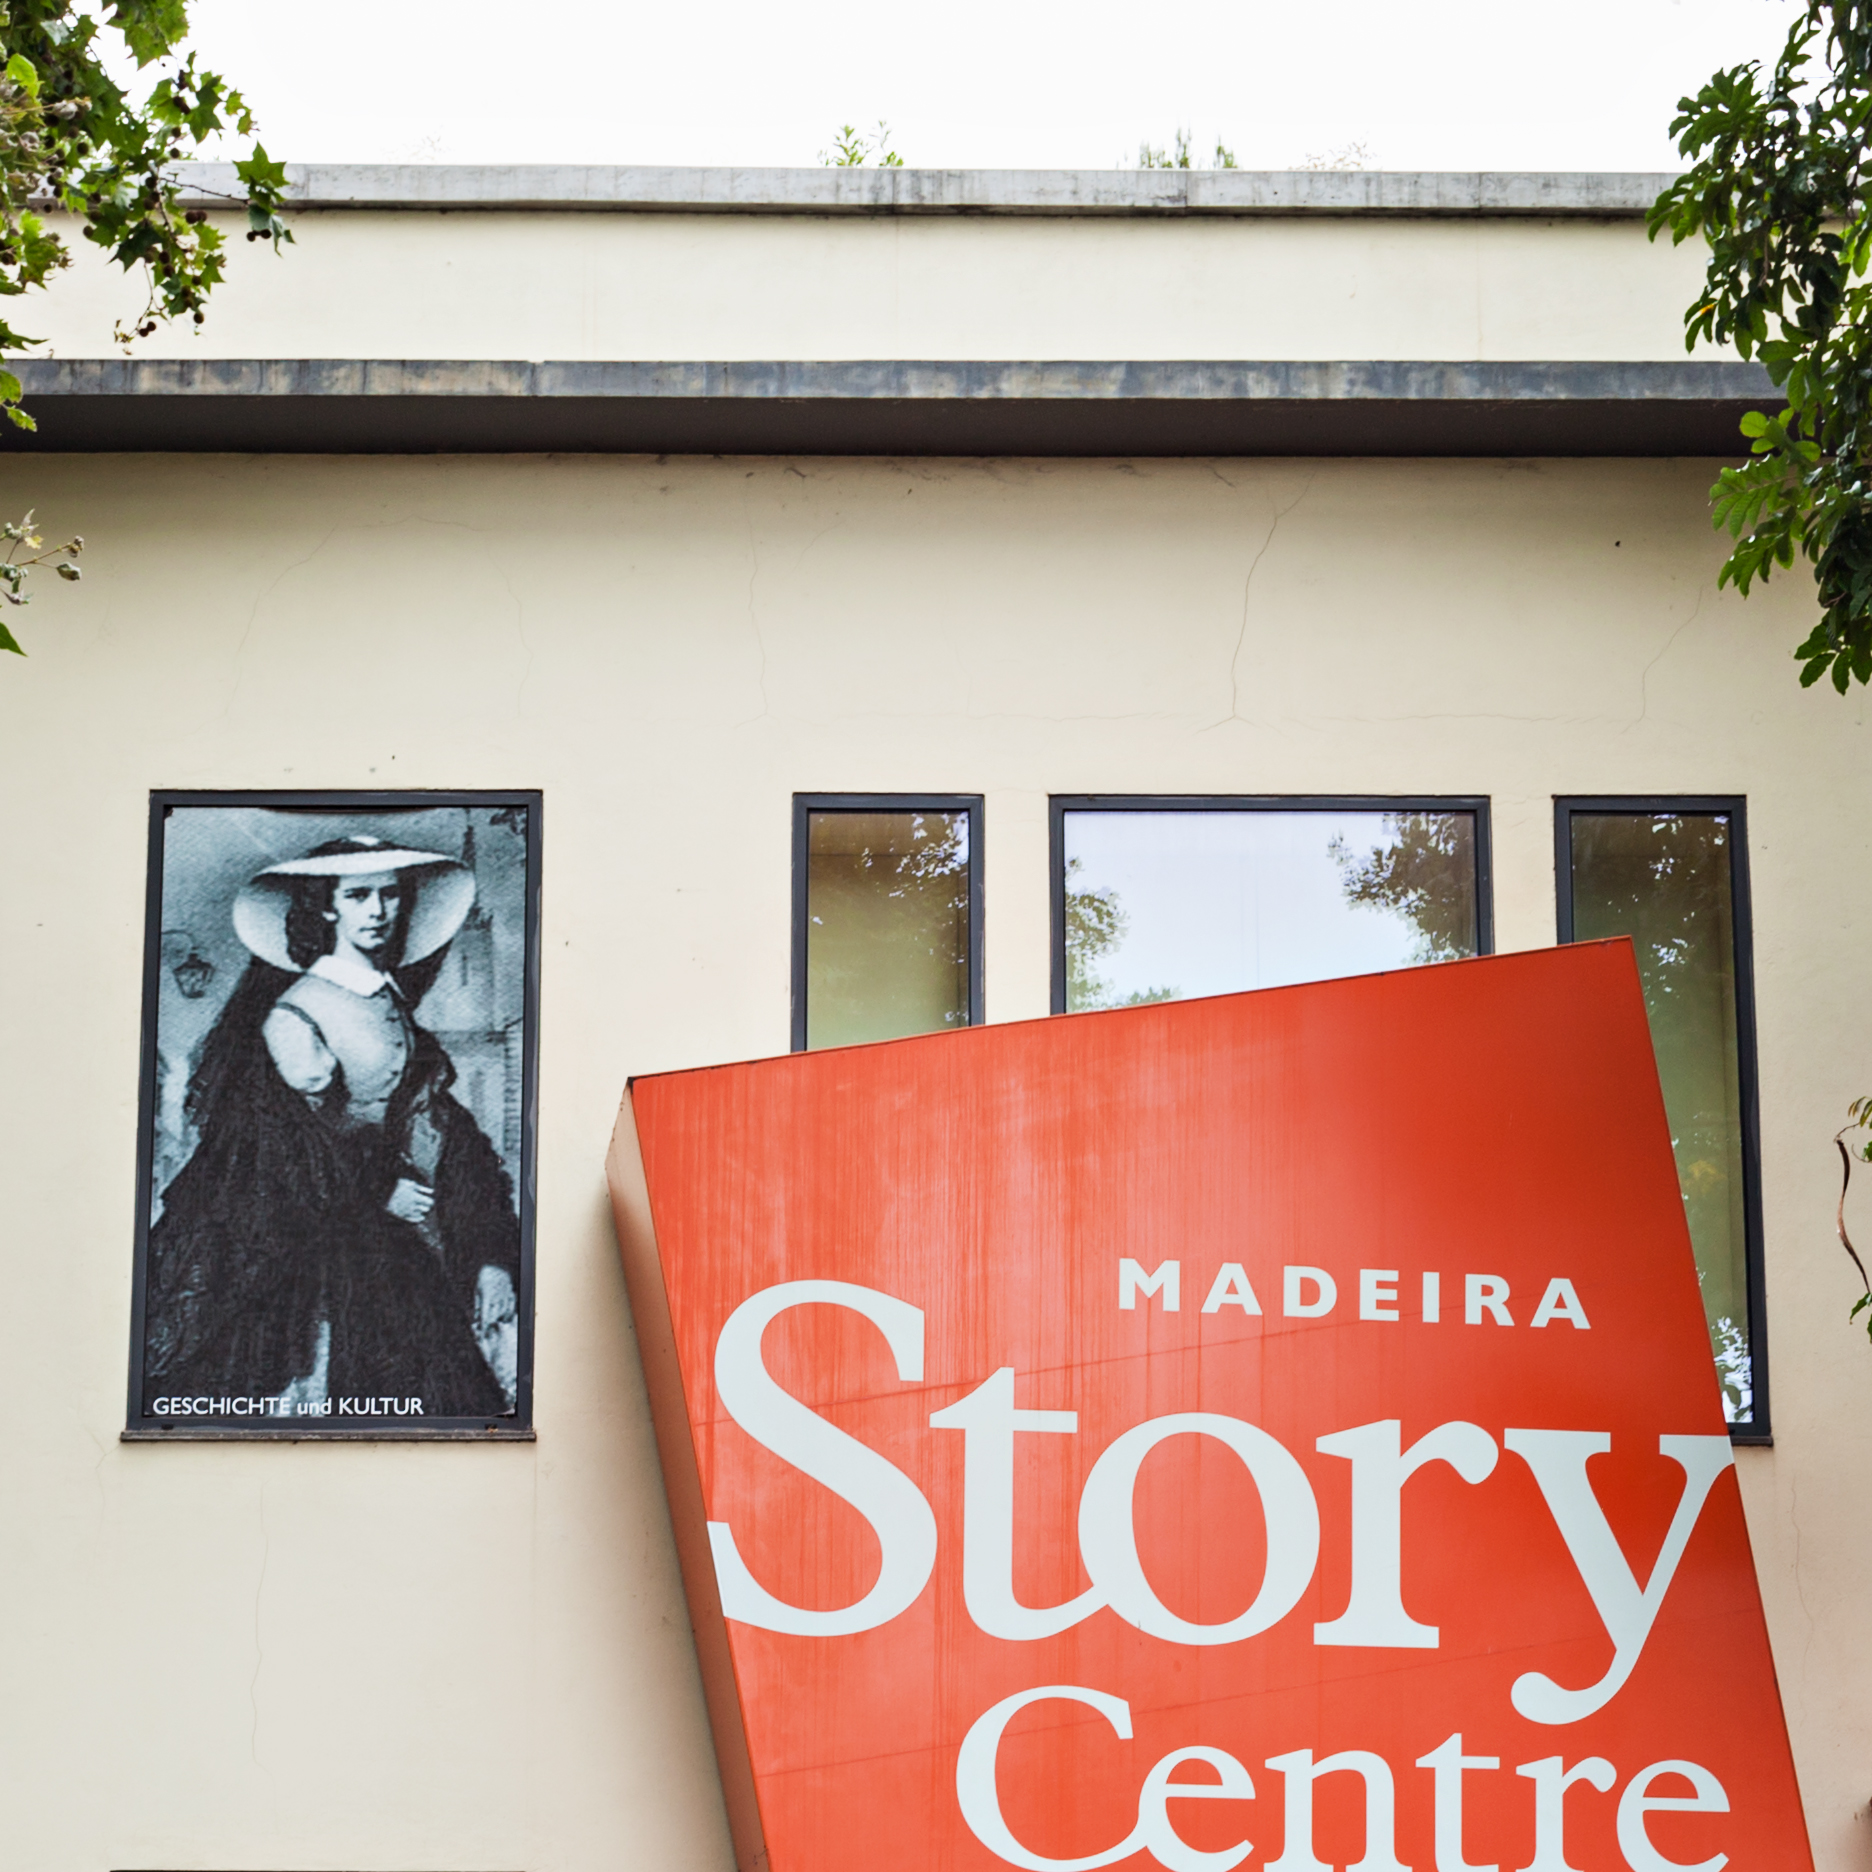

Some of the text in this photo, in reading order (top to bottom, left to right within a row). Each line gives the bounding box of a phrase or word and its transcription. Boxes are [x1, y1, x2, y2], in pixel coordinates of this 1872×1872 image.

[1117, 1255, 1592, 1331] MADEIRA
[152, 1396, 425, 1416] GESCHICHTE und KULTUR
[706, 1277, 1736, 1725] Story
